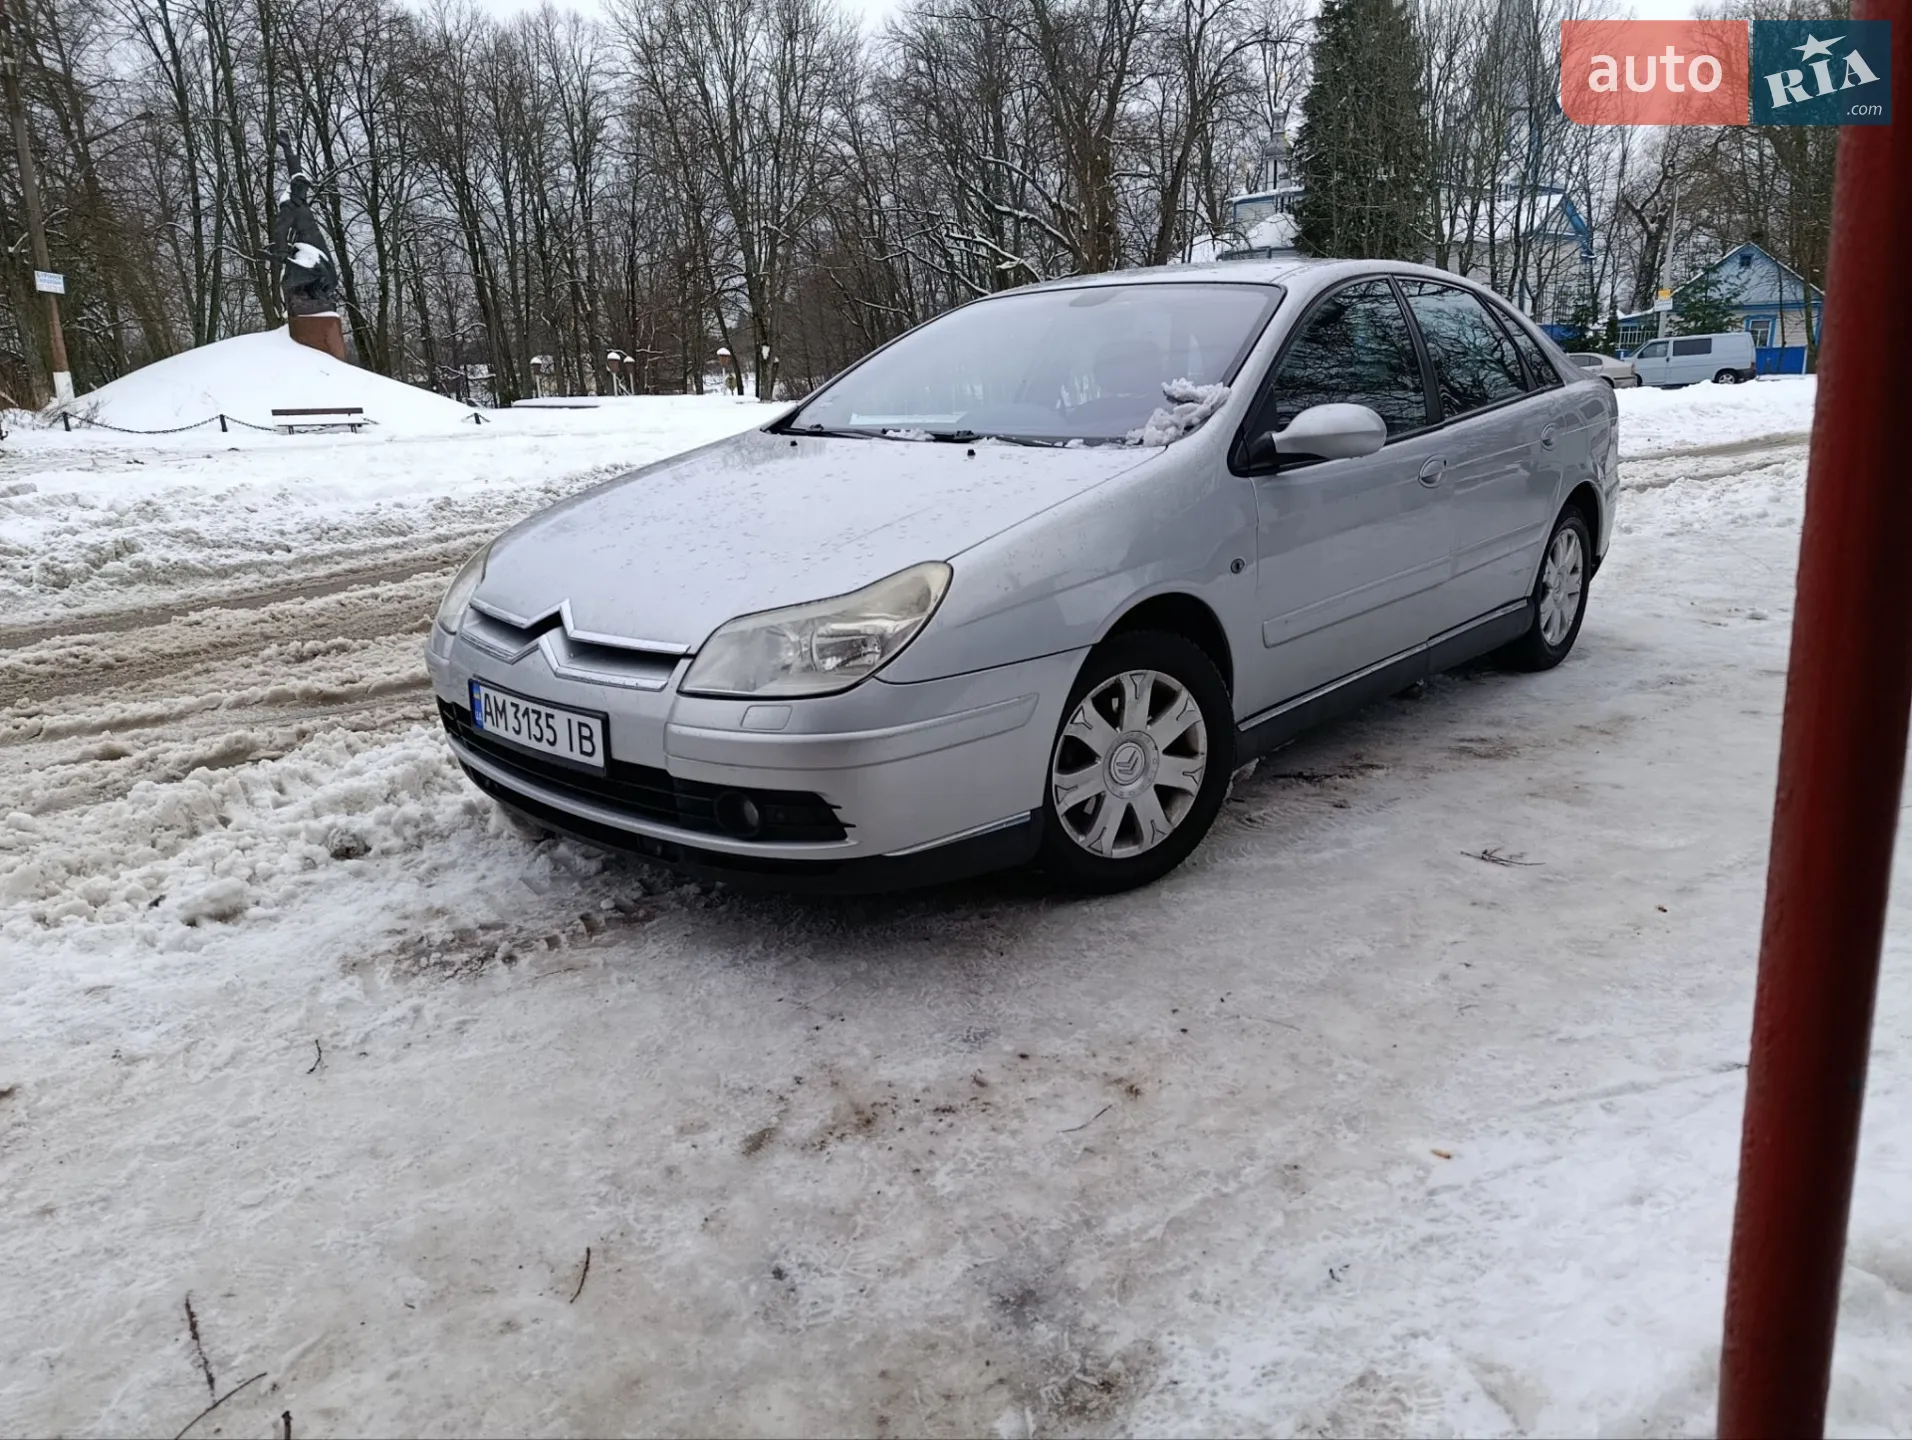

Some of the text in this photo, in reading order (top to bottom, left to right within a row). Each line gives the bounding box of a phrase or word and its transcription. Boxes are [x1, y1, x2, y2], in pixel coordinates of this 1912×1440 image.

[484, 692, 596, 758] AM 3135 IB
